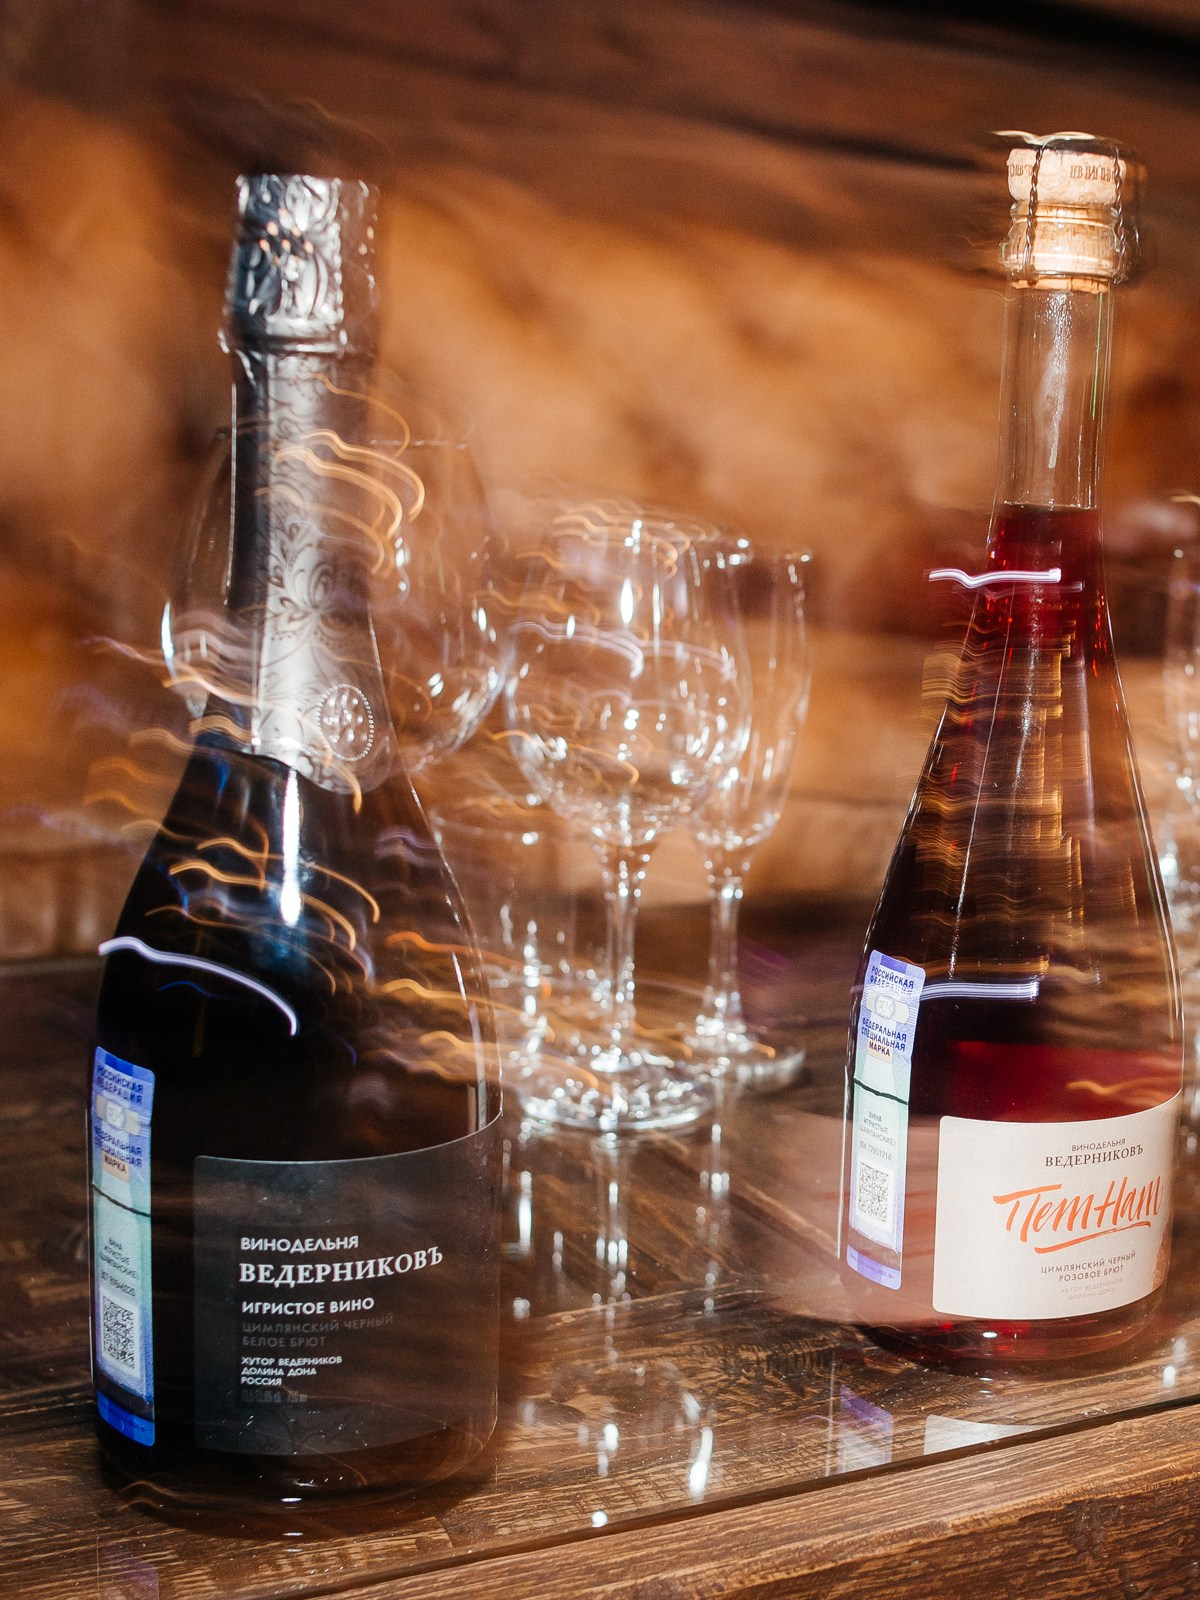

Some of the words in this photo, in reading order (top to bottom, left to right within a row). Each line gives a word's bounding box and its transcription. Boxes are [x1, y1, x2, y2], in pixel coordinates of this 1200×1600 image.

[871, 965, 914, 989] РОССИЙСКАЯ
[862, 1017, 907, 1042] ФЕДЕРАЛЬНАЯ
[861, 1026, 906, 1052] СПЕЦИАЛЬНАЯ
[869, 1041, 891, 1057] МАРКА
[1071, 1138, 1126, 1152] ВИНОДЕЛЬНЯ
[1045, 1144, 1143, 1168] ВЕДЕРНИКОВЪ
[240, 1235, 359, 1254] ВИНОДЕЛЬНЯ
[239, 1246, 443, 1288] ВЕДЕРНИКОВЪ
[1041, 1258, 1105, 1274] ЦИМЛЯНСКИЙ
[1108, 1250, 1136, 1265] ЧЕРНЫЙ
[1058, 1271, 1101, 1282] РОЗОВОЕ
[1103, 1264, 1124, 1277] БРЮТ
[241, 1301, 325, 1315] ИГРИСТОЕ
[329, 1297, 375, 1314] ВИНО
[242, 1319, 340, 1334] ЦИМЛЯНСКИЙ
[343, 1313, 394, 1330] ЧЕРНЫЙ
[242, 1336, 286, 1347] БЕЛОЕ
[290, 1335, 326, 1348] БРЮТ
[241, 1356, 275, 1366] ХУТОР
[278, 1356, 343, 1367] ВЕДЕРНИКОВ
[240, 1376, 282, 1386] РОССИЯ
[241, 1367, 284, 1376] ДОЛИНА
[287, 1367, 317, 1377] ДОНА
